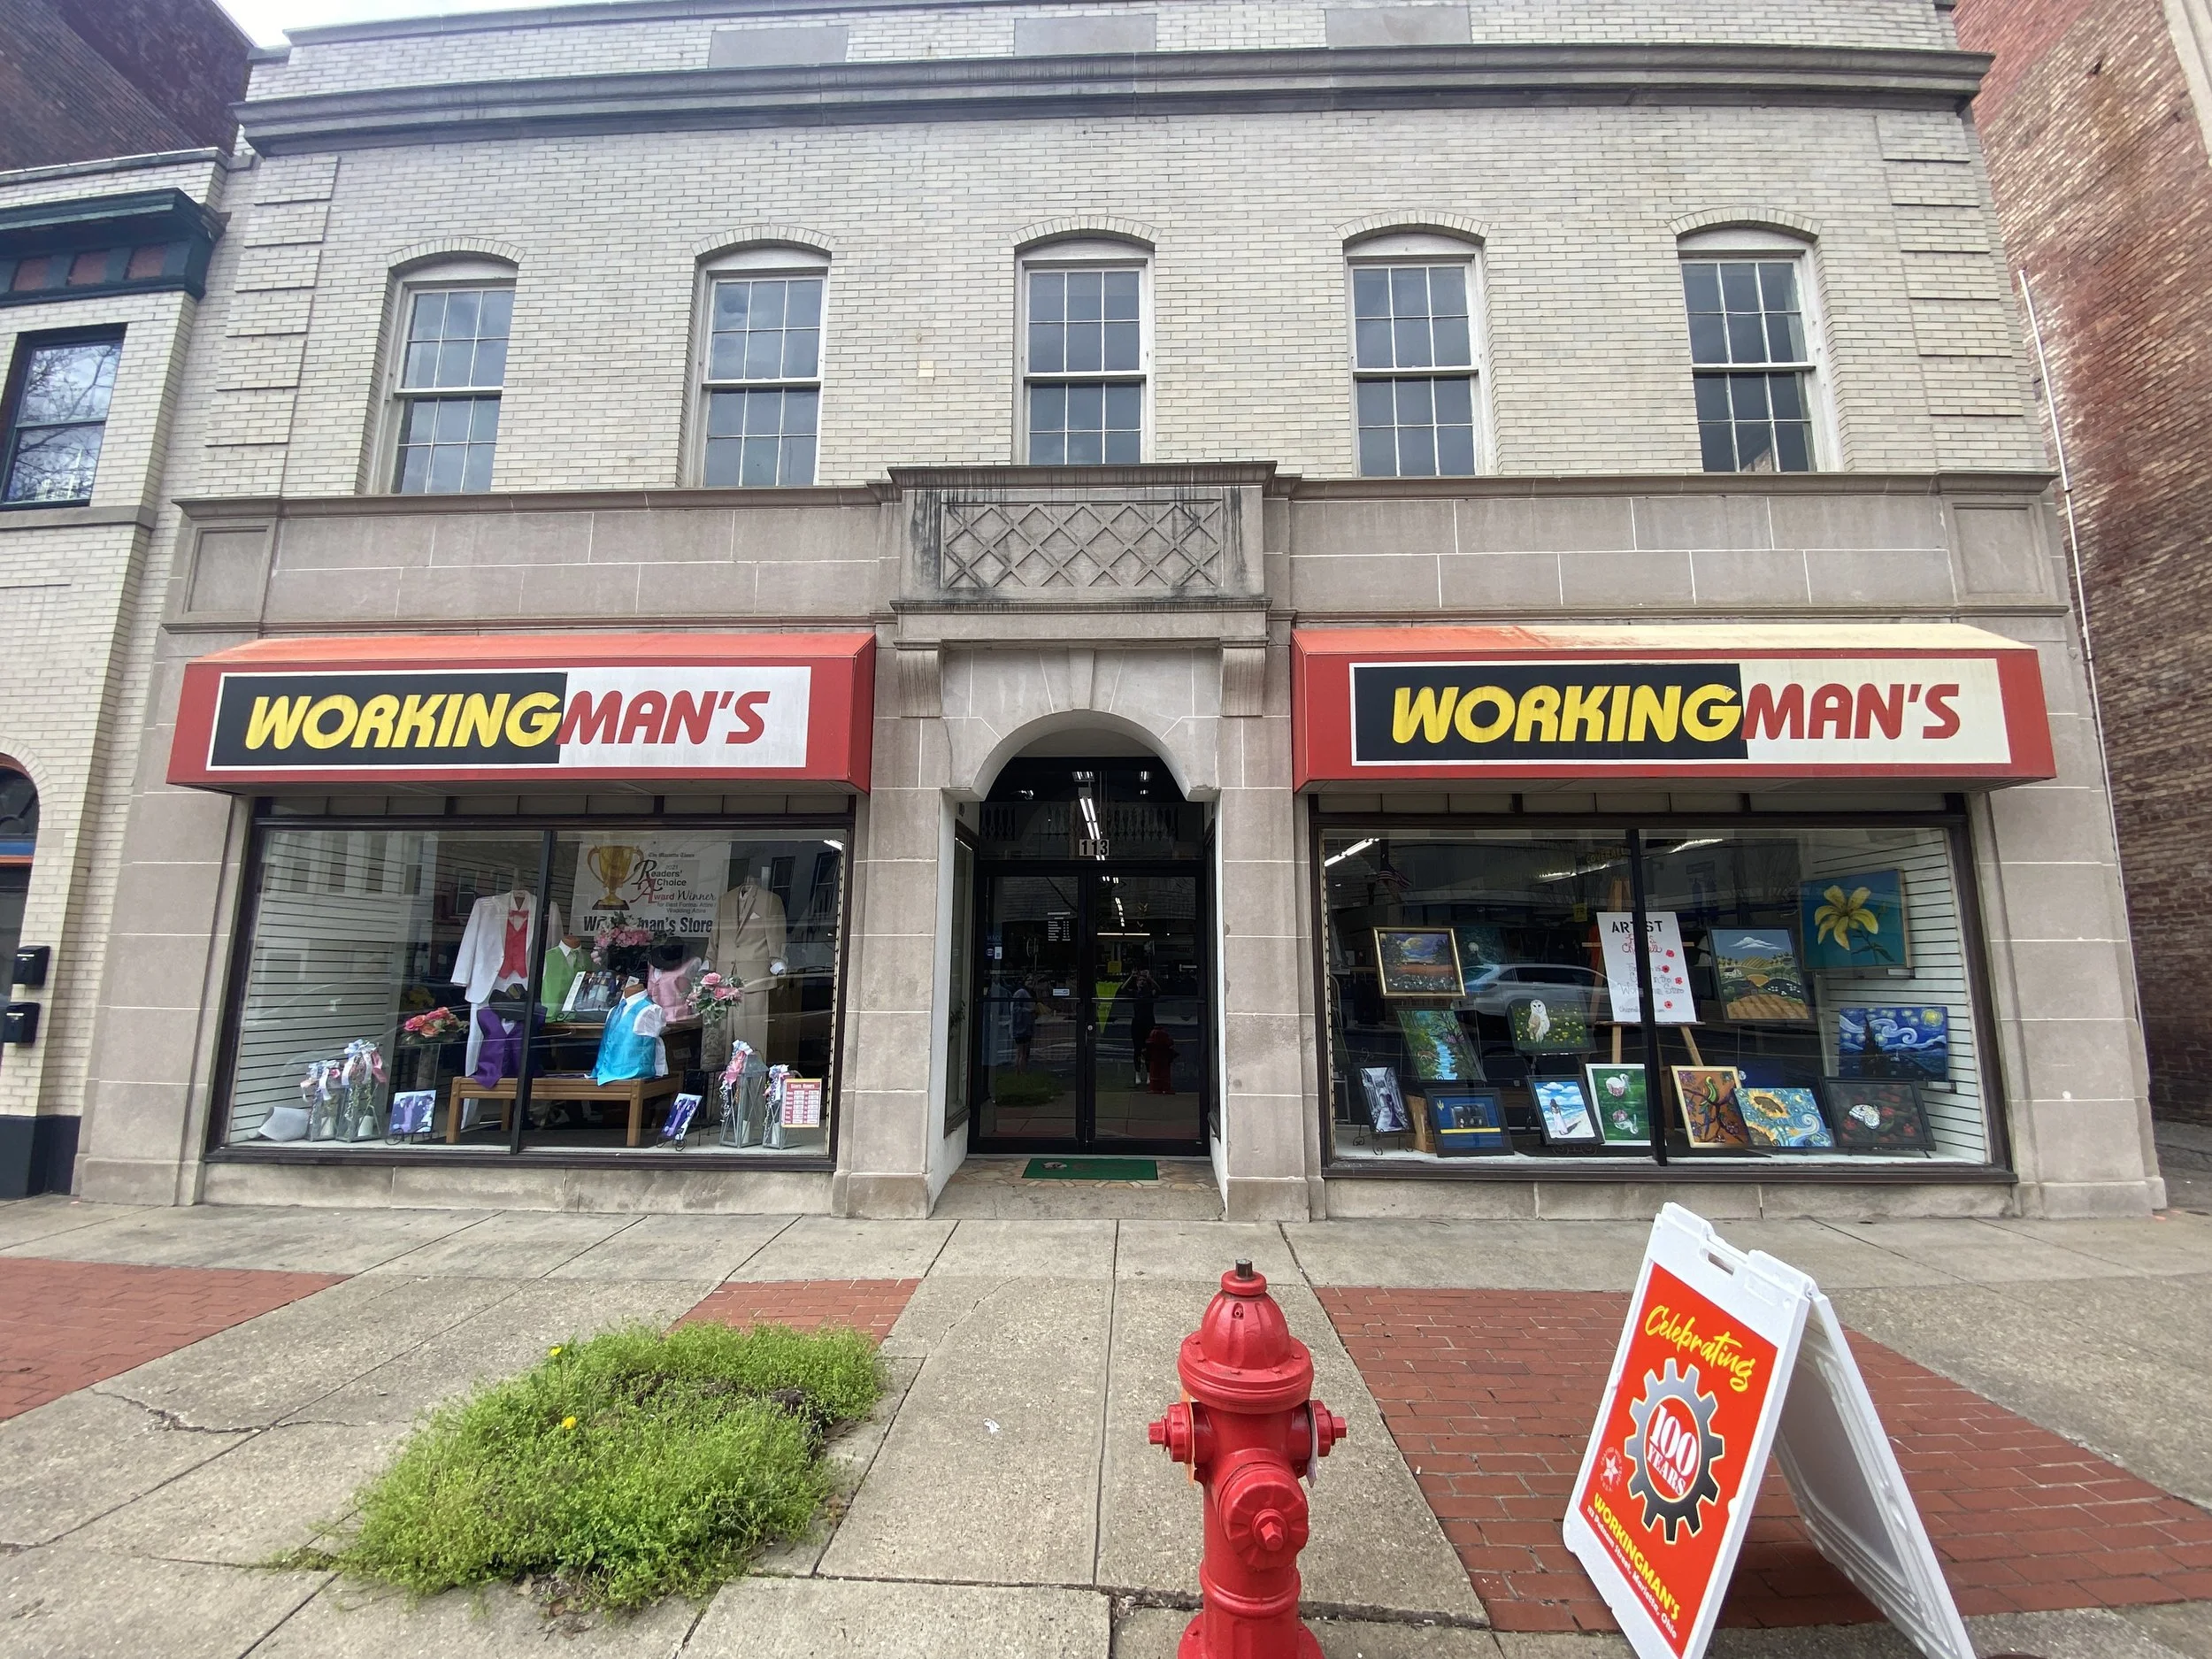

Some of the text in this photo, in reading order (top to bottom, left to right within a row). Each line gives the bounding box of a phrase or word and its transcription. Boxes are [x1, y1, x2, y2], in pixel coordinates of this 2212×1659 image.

[1081, 840, 1108, 856] 113
[629, 877, 716, 903] Award Winner
[680, 917, 713, 933] Store
[1611, 921, 1663, 933] ARST
[1645, 1305, 1755, 1392] Celebrating
[1649, 1404, 1697, 1477] 100
[1647, 1443, 1686, 1496] YEARS
[1594, 1493, 1680, 1621] WORKINGMAN'S
[1594, 1517, 1615, 1548] Putnam
[1661, 1613, 1677, 1640] Ohio
